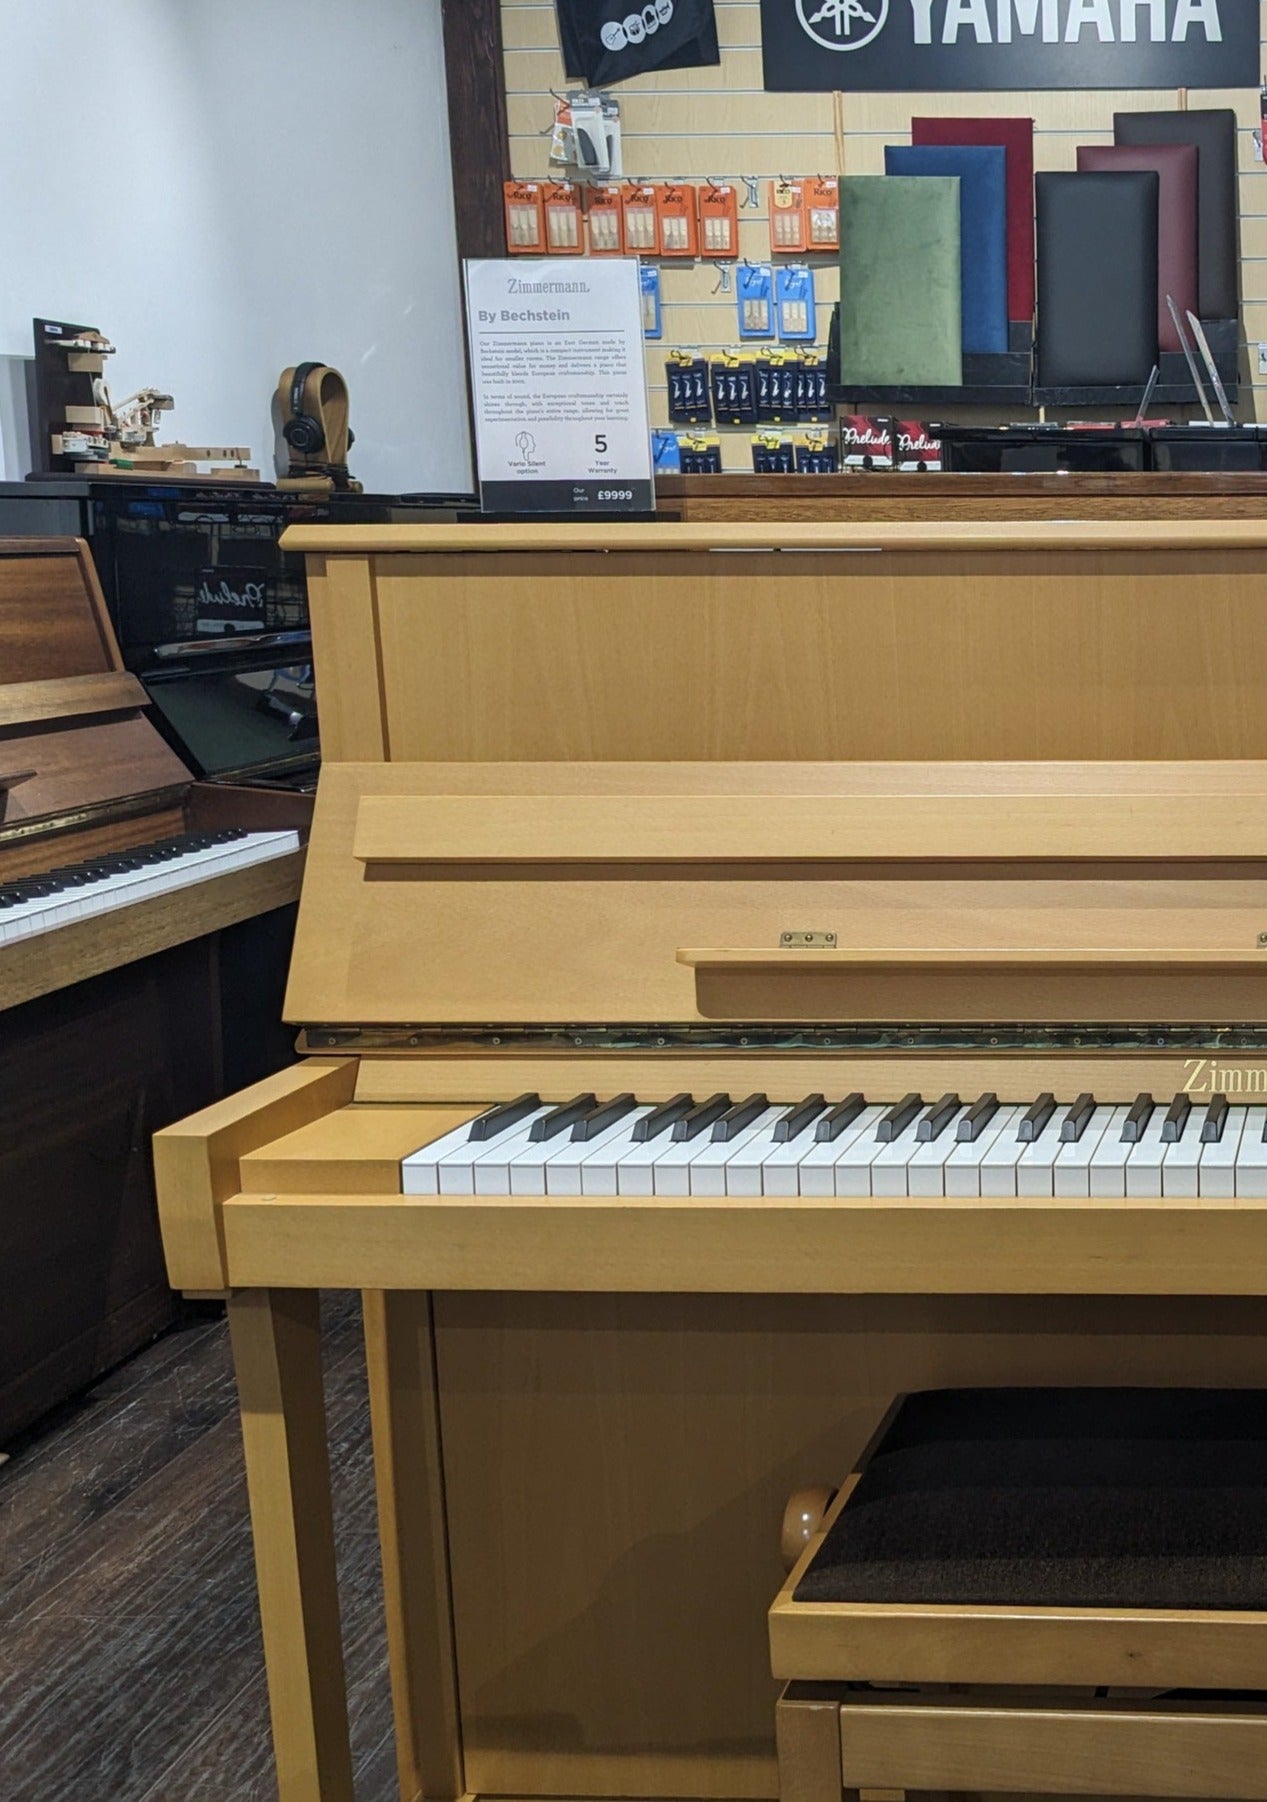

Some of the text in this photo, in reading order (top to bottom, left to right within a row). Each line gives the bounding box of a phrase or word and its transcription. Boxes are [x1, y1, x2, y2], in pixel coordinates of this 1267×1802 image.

[909, 0, 1223, 44] YAMAHA
[478, 309, 570, 323] By Bechstein
[594, 434, 608, 453] 5
[842, 427, 892, 445] Prelude
[597, 490, 633, 501] £9999
